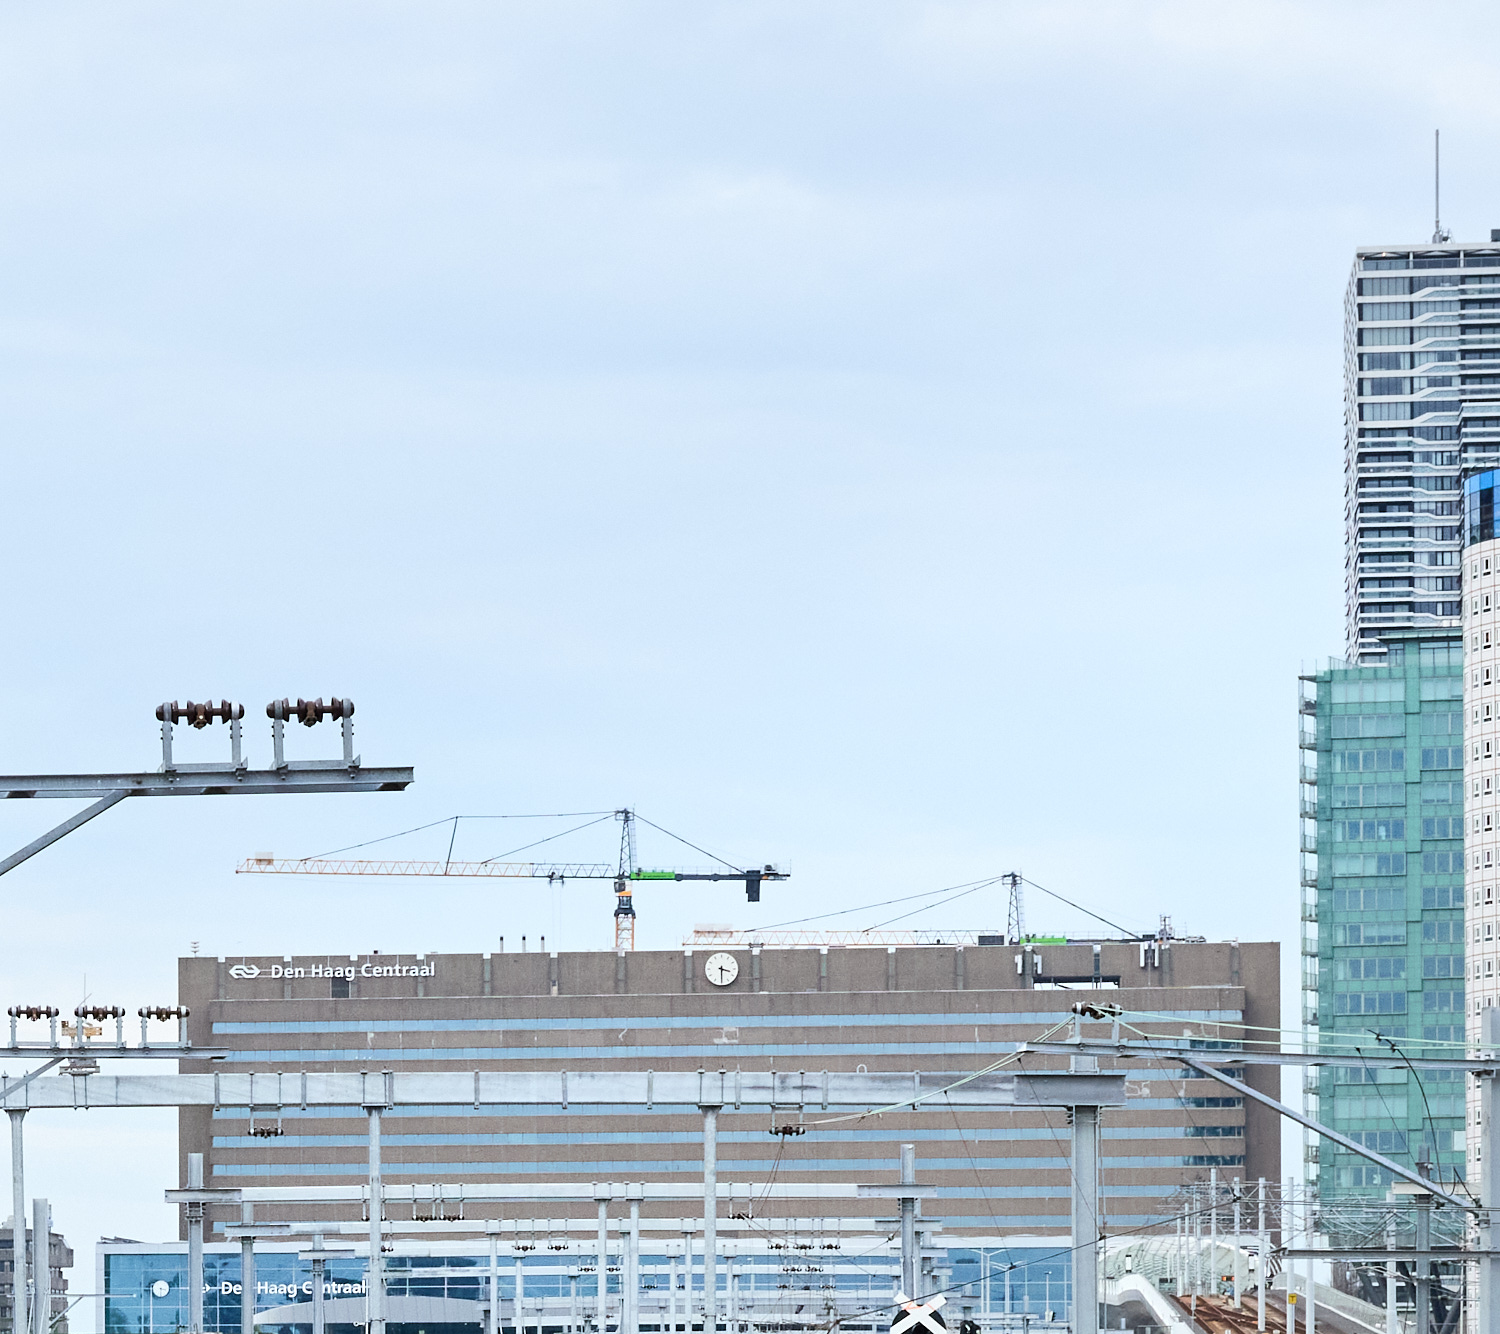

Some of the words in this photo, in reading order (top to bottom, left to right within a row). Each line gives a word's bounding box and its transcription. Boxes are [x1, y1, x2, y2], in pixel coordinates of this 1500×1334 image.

[271, 964, 305, 979] Den
[311, 963, 355, 981] Haag
[360, 961, 435, 978] Centraal
[220, 1281, 243, 1295] De
[257, 1281, 297, 1298] Haag
[301, 1280, 366, 1295] Cntraal
